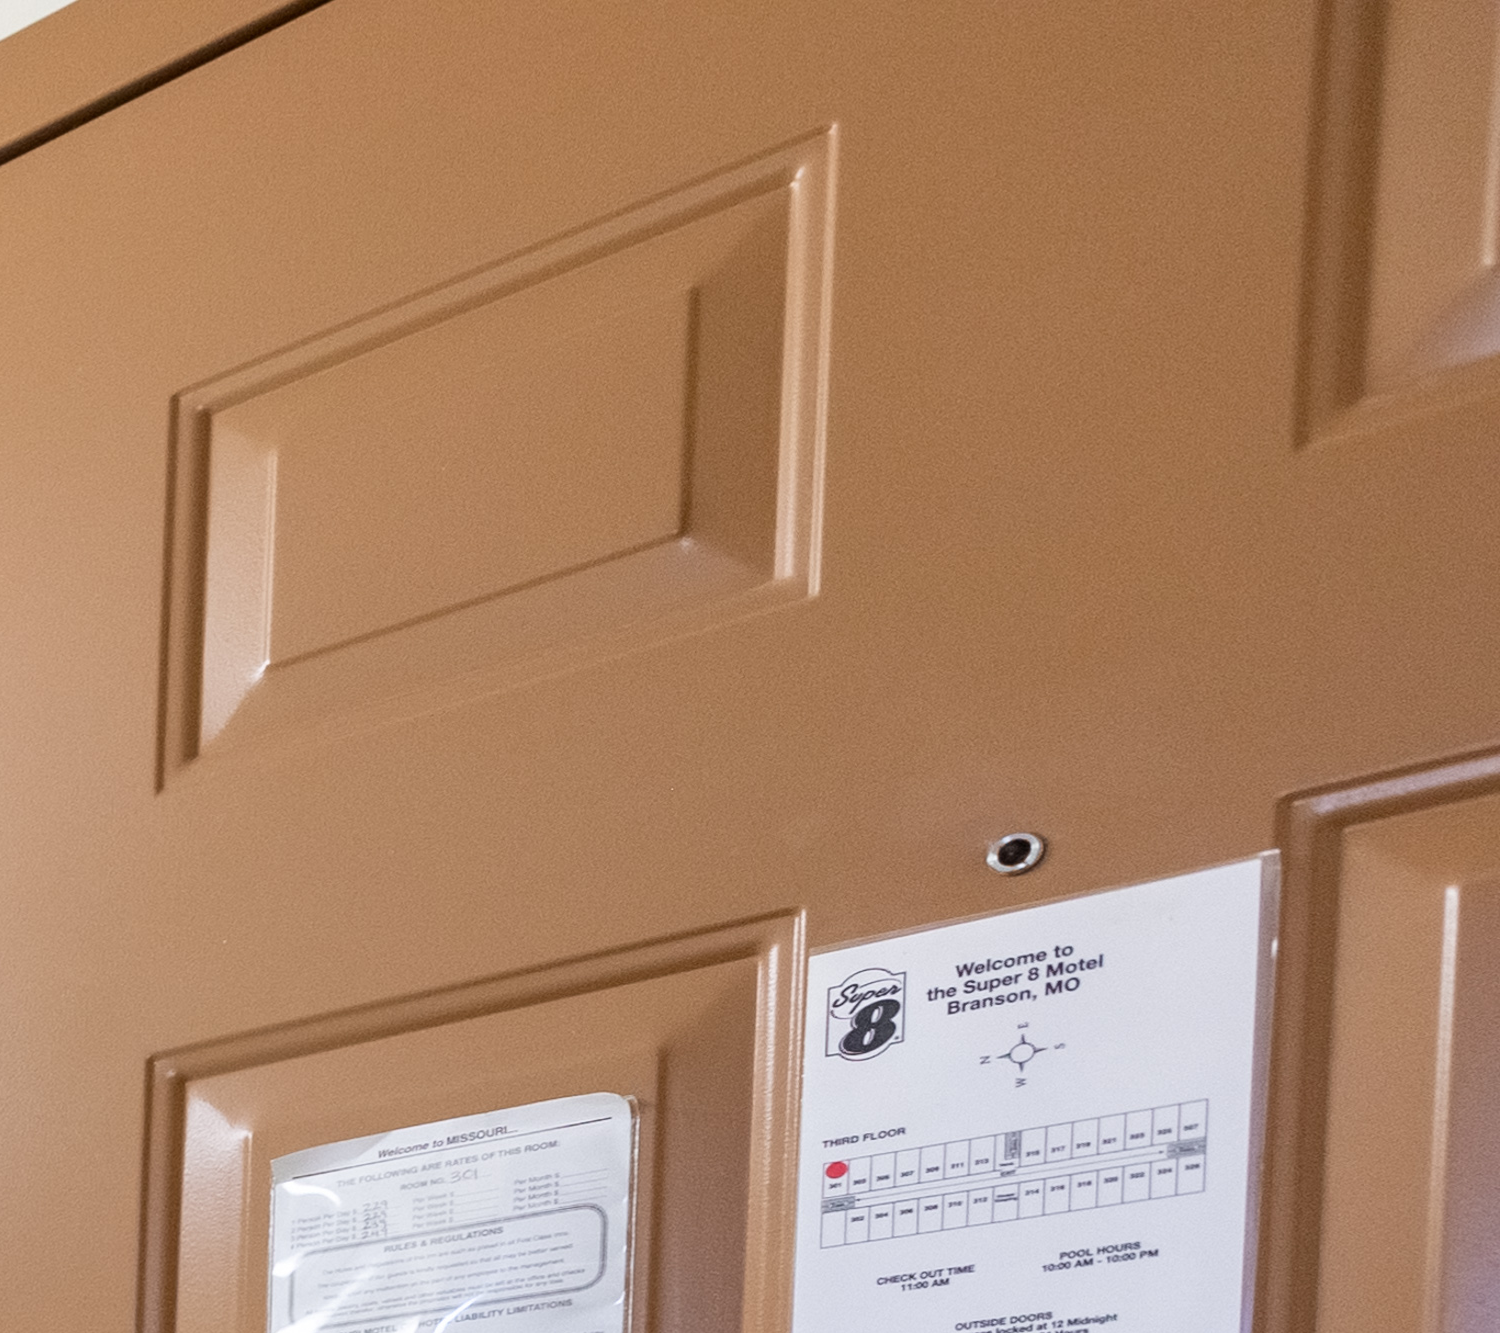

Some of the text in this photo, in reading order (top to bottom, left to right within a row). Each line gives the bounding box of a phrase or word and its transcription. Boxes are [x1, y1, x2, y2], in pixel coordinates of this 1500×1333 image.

[956, 945, 1074, 978] Welcome to
[927, 954, 1104, 1002] the Super 8 Motel
[832, 983, 902, 1016] Super
[947, 977, 1081, 1016] Branson, MO
[838, 998, 901, 1056] 8
[377, 1140, 430, 1159] Welcome
[432, 1137, 444, 1149] to
[822, 1126, 906, 1148] THIRD FLOOR
[336, 1177, 357, 1188] THE
[359, 1165, 417, 1184] FOLLOWING
[420, 1161, 442, 1173] ARE
[445, 1153, 479, 1168] RATES
[481, 1150, 497, 1161] OF
[498, 1145, 521, 1158] THIS
[399, 1178, 428, 1192] ROOM
[383, 1226, 503, 1253] RULES & REGULATIONS
[1059, 1241, 1141, 1260] POOL HOURS
[1042, 1260, 1071, 1272] 10:00
[1074, 1257, 1094, 1268] AM
[1106, 1251, 1136, 1263] 10:00
[1139, 1248, 1158, 1258] PM
[876, 1264, 975, 1285] CHECK OUT TIME
[901, 1277, 949, 1291] 11:00 AM
[455, 1308, 504, 1322] LIABILITY
[506, 1298, 572, 1315] LIMITATIONS
[954, 1311, 1053, 1331] OUTSIDE DOORS
[1037, 1322, 1047, 1330] at
[1052, 1319, 1064, 1328] 12
[1067, 1312, 1117, 1329] Midnight
